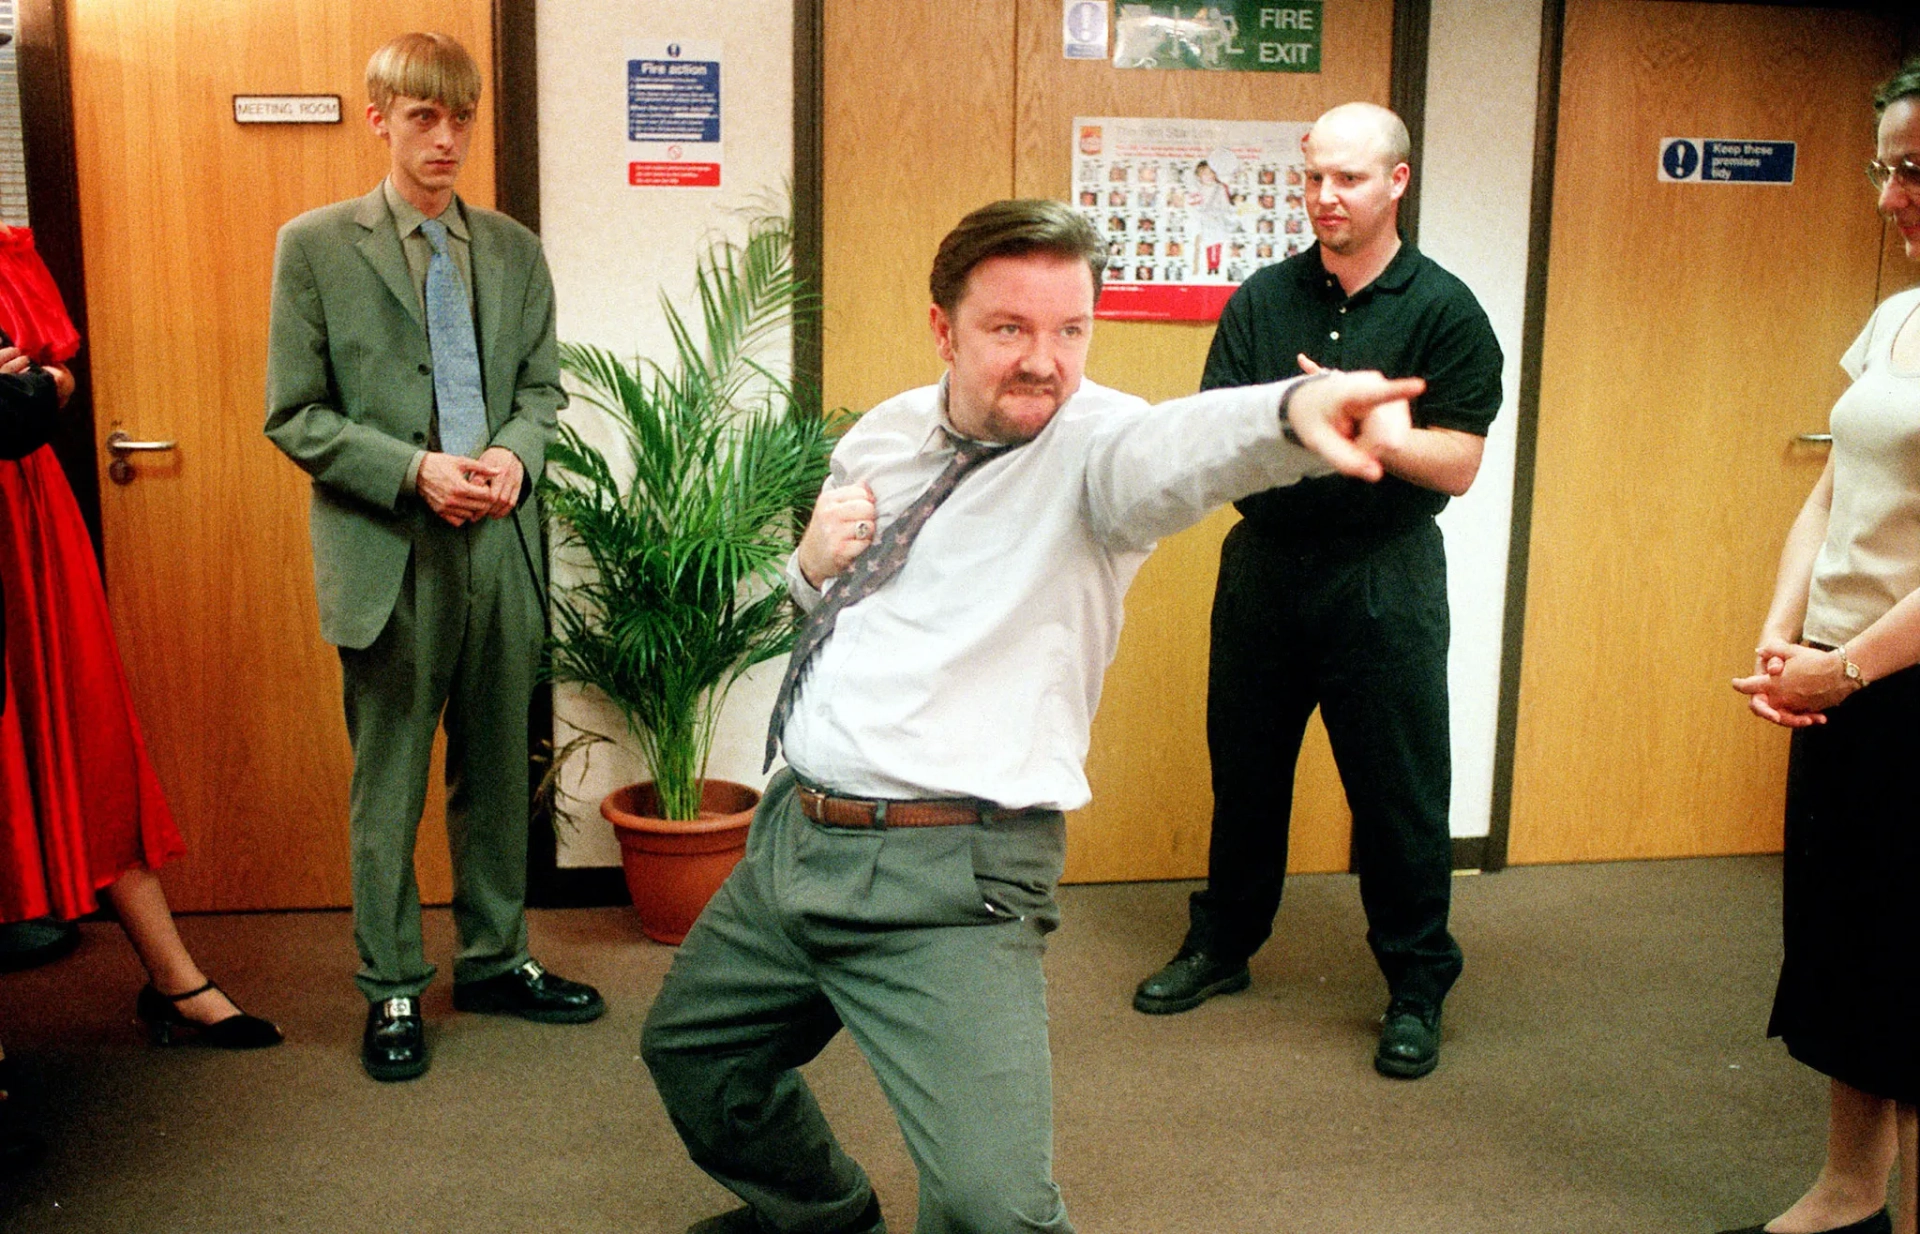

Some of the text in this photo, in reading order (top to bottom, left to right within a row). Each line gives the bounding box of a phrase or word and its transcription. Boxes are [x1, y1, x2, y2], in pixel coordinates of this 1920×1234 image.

[1259, 8, 1314, 30] FIRE
[1259, 42, 1313, 64] EXIT
[641, 62, 666, 75] Fire
[238, 103, 337, 115] MEETING ROOM
[1713, 144, 1773, 155] Keep these
[1711, 157, 1761, 167] premises
[1711, 168, 1732, 180] tidy
